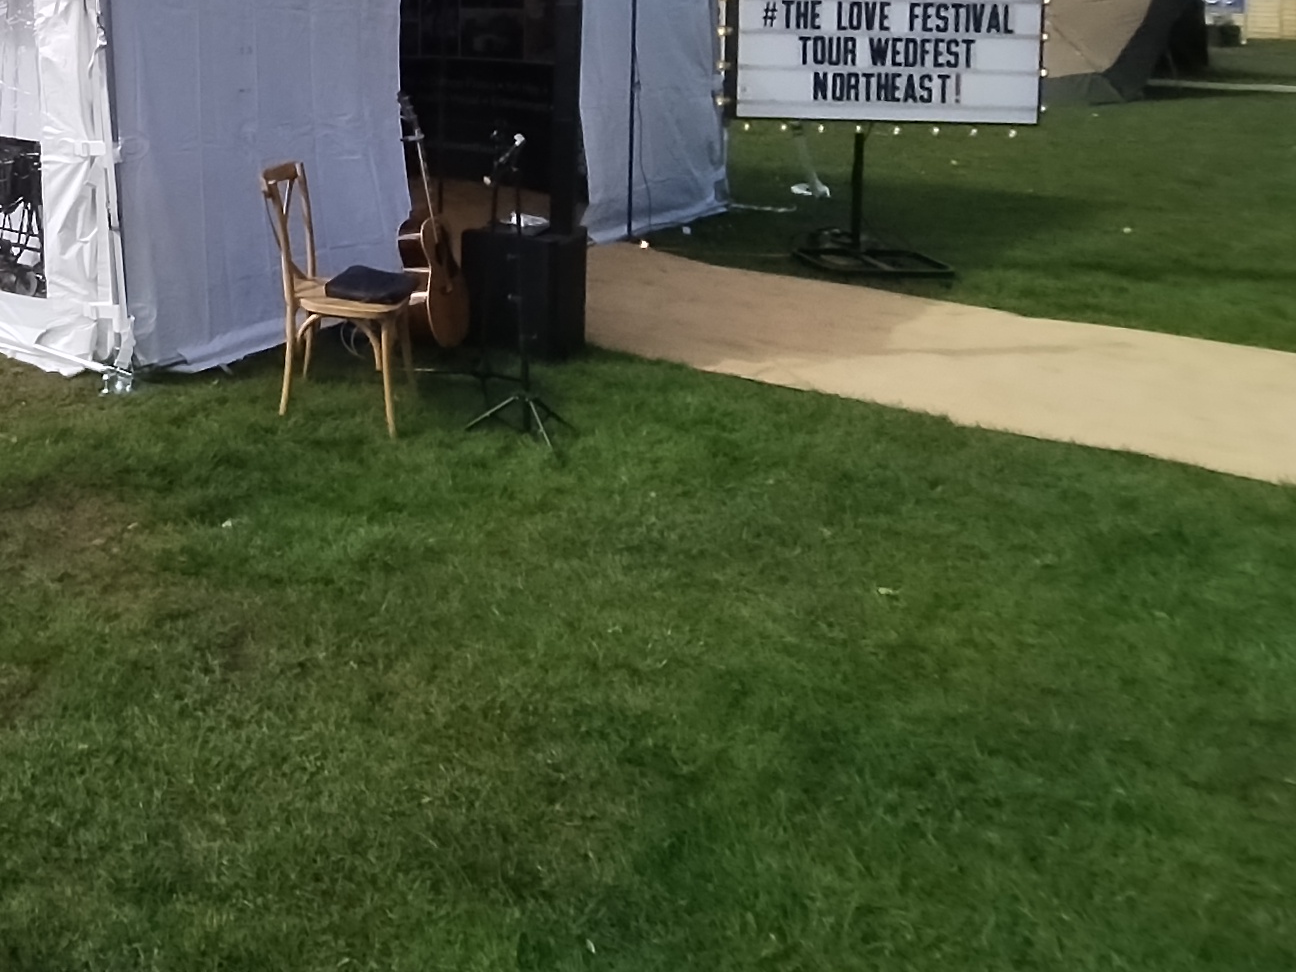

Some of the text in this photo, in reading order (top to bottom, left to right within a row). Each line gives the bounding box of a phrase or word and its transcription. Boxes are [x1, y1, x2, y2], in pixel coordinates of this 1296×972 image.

[763, 0, 1014, 35] #THE LOVE FESTIVAL
[798, 35, 977, 68] TOUR WEDFEST
[811, 71, 962, 104] NORTHEAST!
